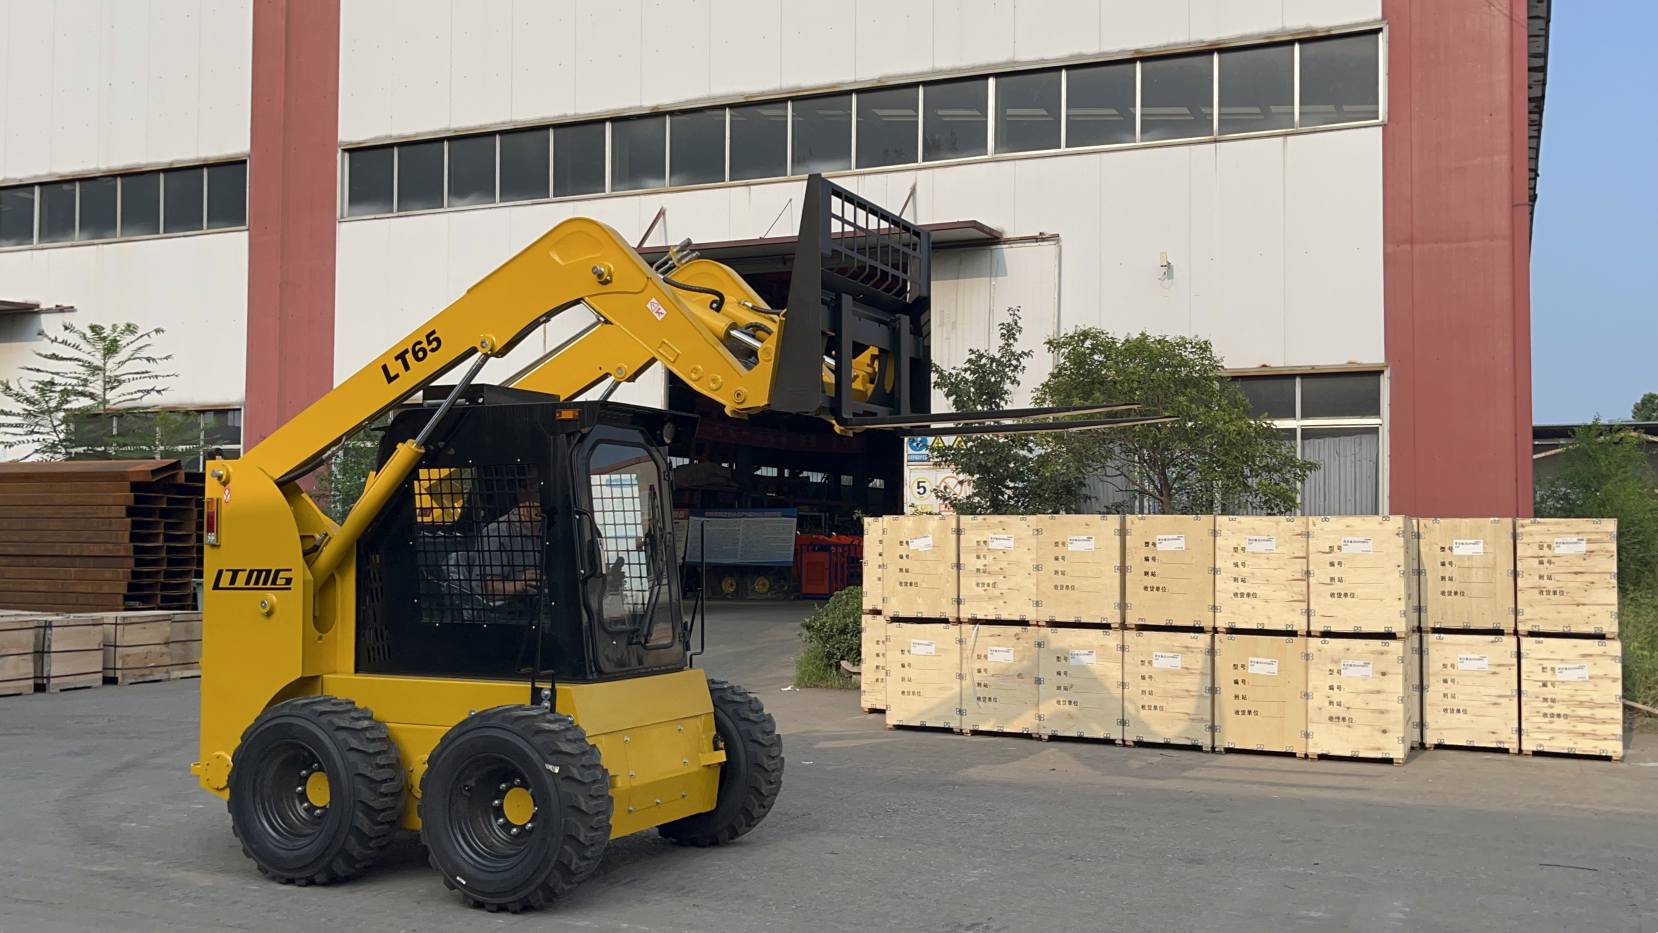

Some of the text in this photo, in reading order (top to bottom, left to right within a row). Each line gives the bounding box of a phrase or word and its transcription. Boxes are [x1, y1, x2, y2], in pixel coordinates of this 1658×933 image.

[381, 329, 443, 385] LT65
[916, 480, 927, 495] 5
[212, 568, 293, 591] LTMG
